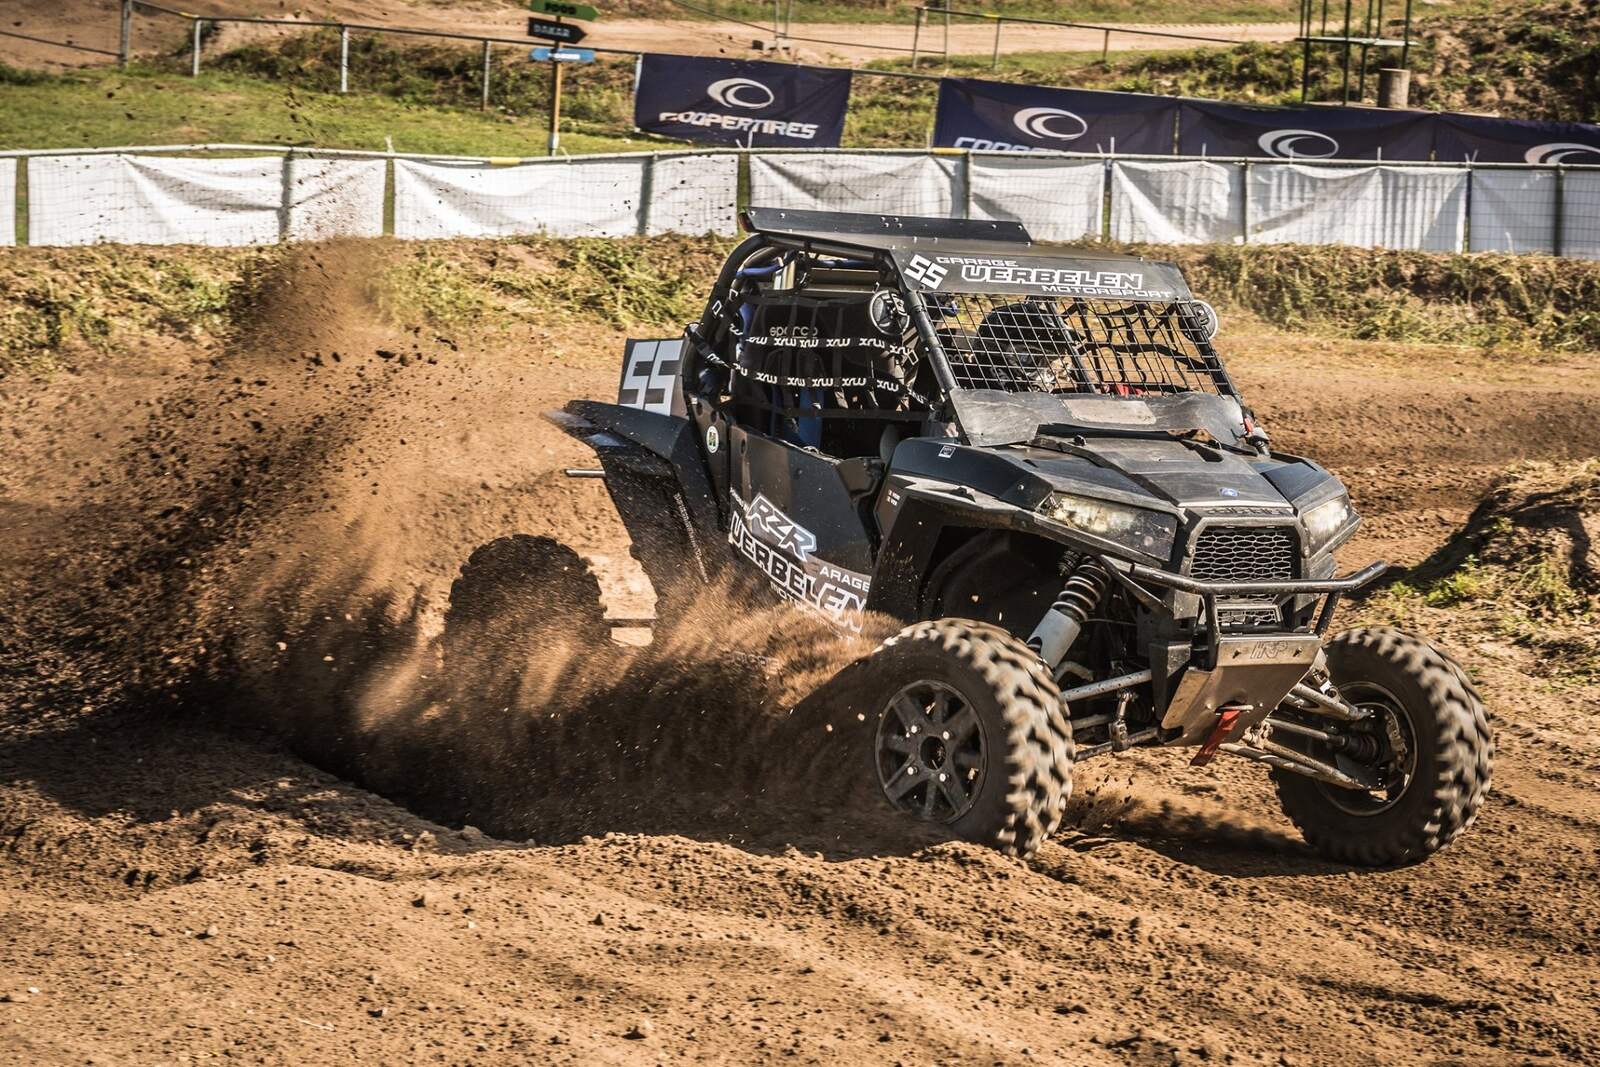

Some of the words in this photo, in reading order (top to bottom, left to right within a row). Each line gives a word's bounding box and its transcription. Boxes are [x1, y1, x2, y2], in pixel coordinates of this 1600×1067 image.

[904, 254, 949, 289] 55
[936, 256, 1019, 267] GARAGE
[961, 264, 1143, 290] VERBELEN
[1041, 284, 1172, 298] MOTORSPORT
[619, 340, 683, 416] 55
[746, 493, 817, 562] RZR
